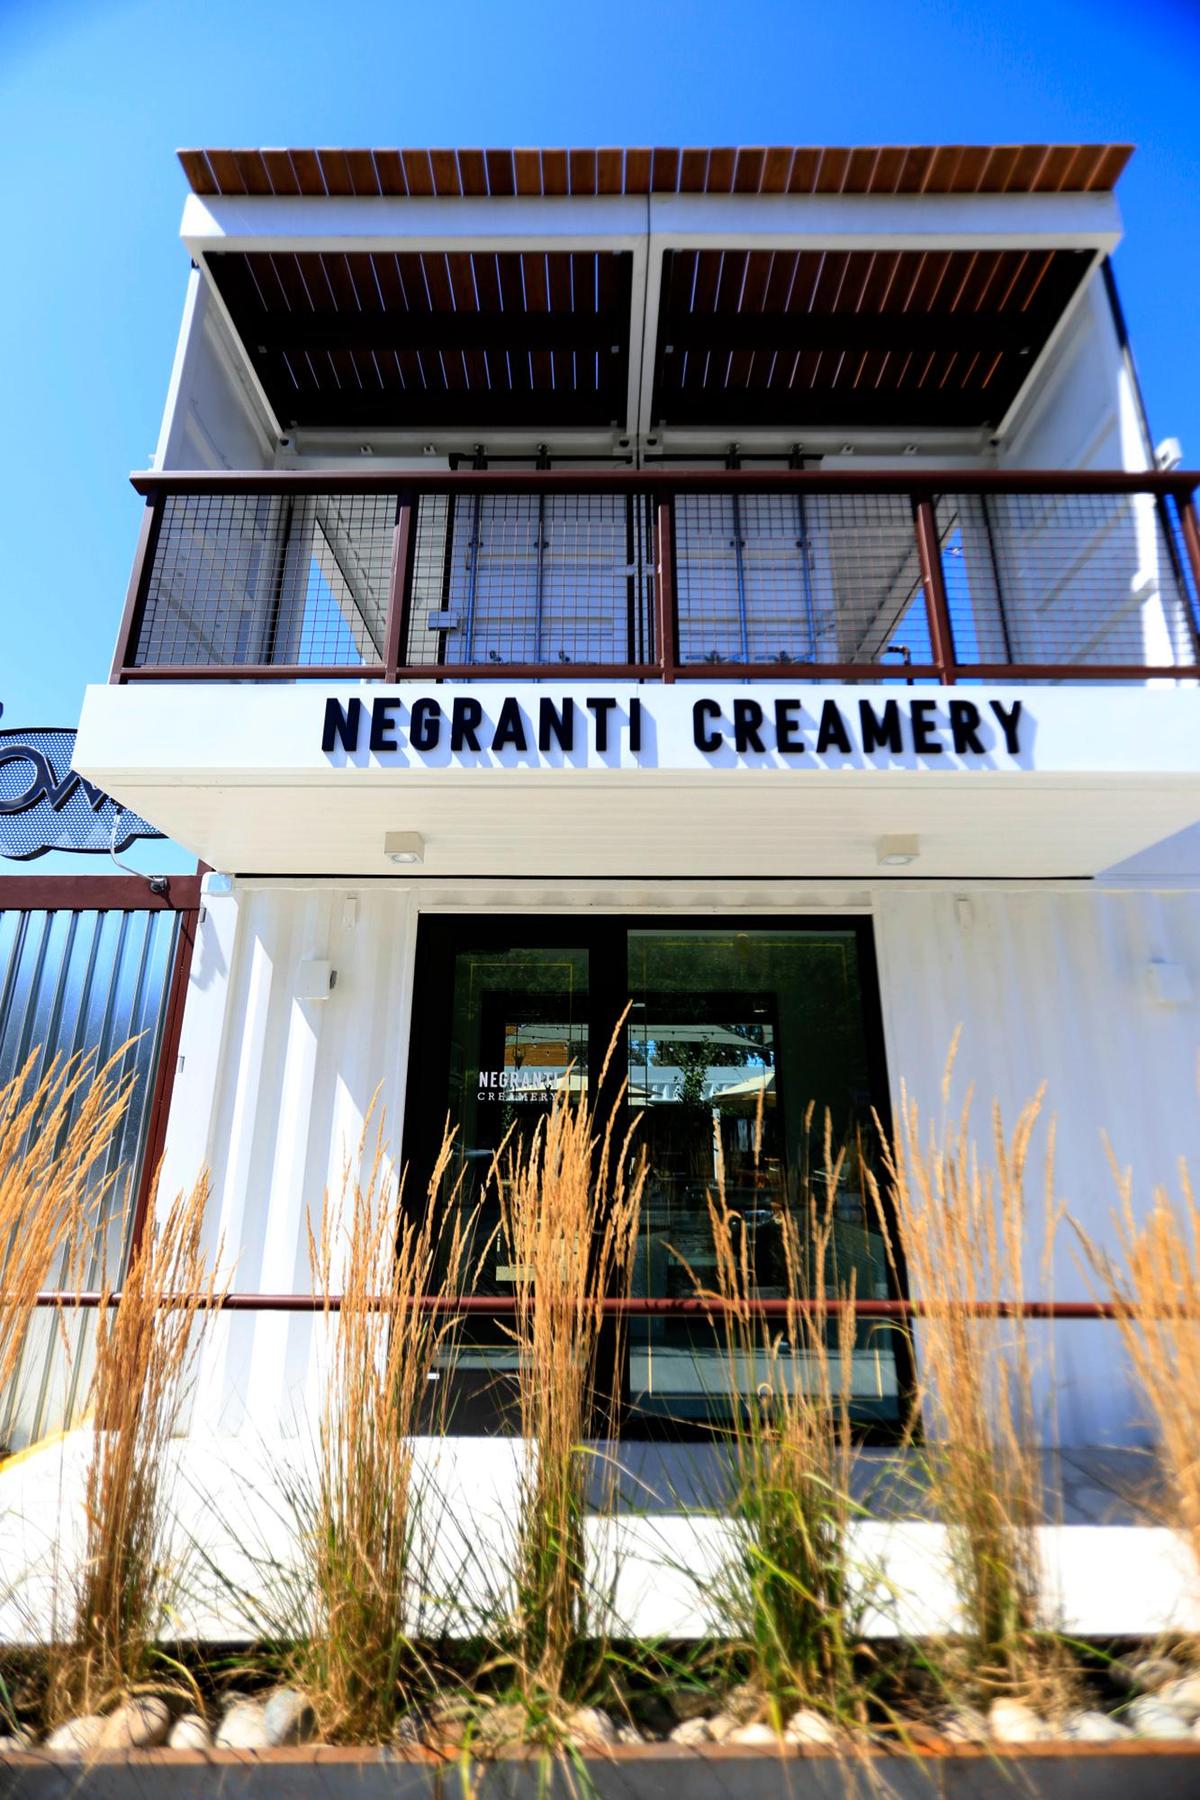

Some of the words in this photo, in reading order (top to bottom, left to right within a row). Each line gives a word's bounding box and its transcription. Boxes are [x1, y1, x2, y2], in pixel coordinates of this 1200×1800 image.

[321, 697, 641, 752] NEGRANTI
[692, 698, 1023, 754] CREAMERY
[479, 1071, 558, 1088] NEGRANTI
